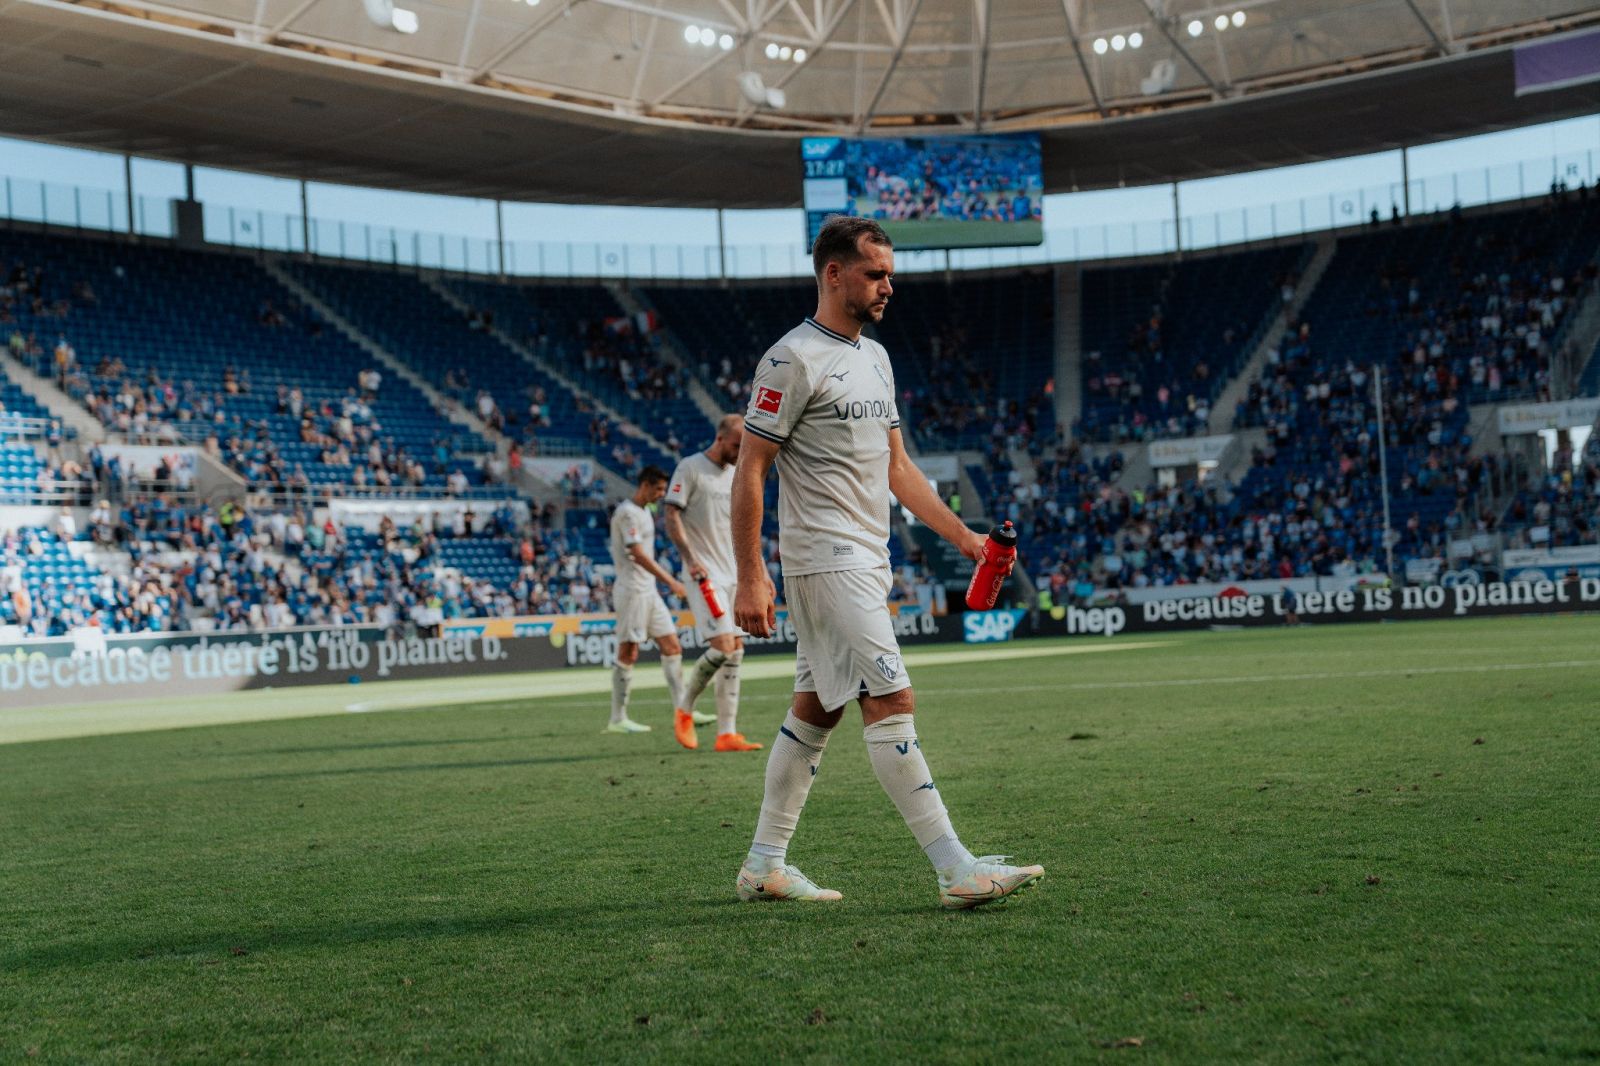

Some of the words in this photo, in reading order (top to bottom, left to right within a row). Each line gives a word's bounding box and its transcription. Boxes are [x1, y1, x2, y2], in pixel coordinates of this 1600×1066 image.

[1143, 594, 1265, 622] because
[1362, 588, 1394, 611] is
[1401, 585, 1445, 610] no
[963, 612, 1015, 642] SAP
[1067, 605, 1126, 637] hep
[286, 642, 319, 673] is
[326, 641, 370, 671] no
